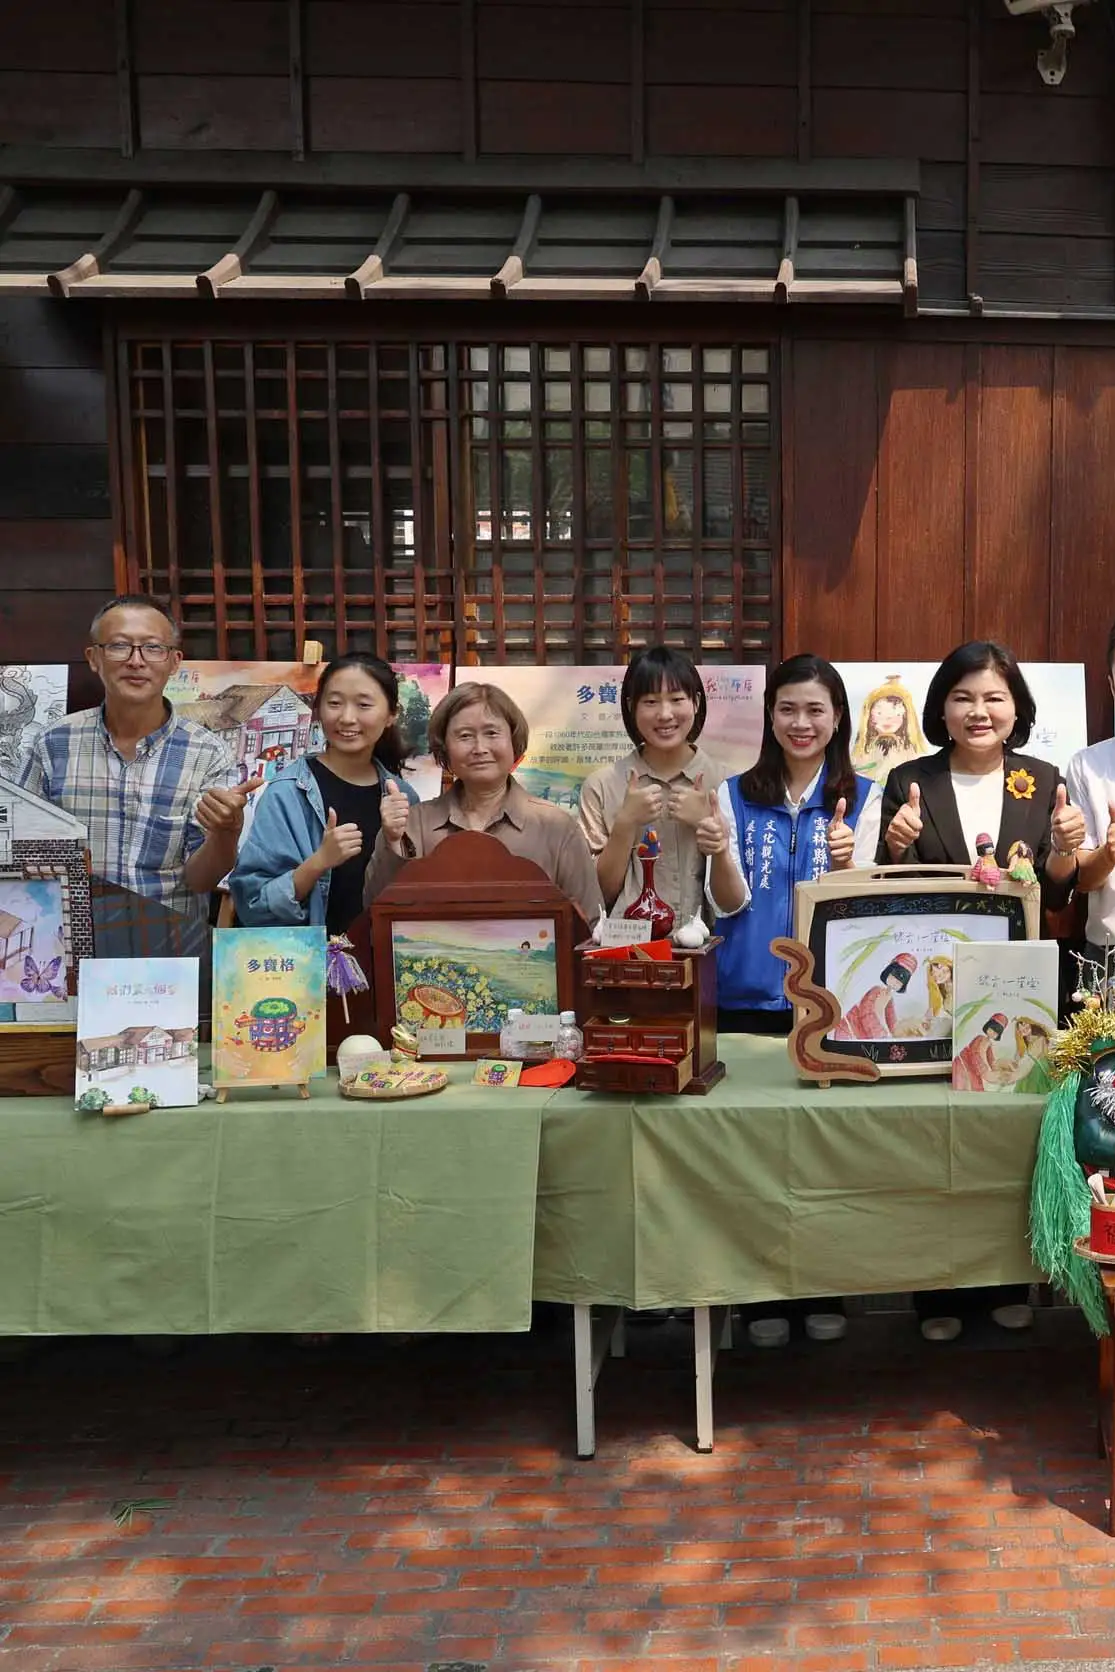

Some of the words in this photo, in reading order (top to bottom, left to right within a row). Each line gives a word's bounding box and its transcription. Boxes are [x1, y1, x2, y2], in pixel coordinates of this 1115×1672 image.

[759, 819, 777, 889] 文化觀光處
[247, 955, 295, 973] 多寶格
